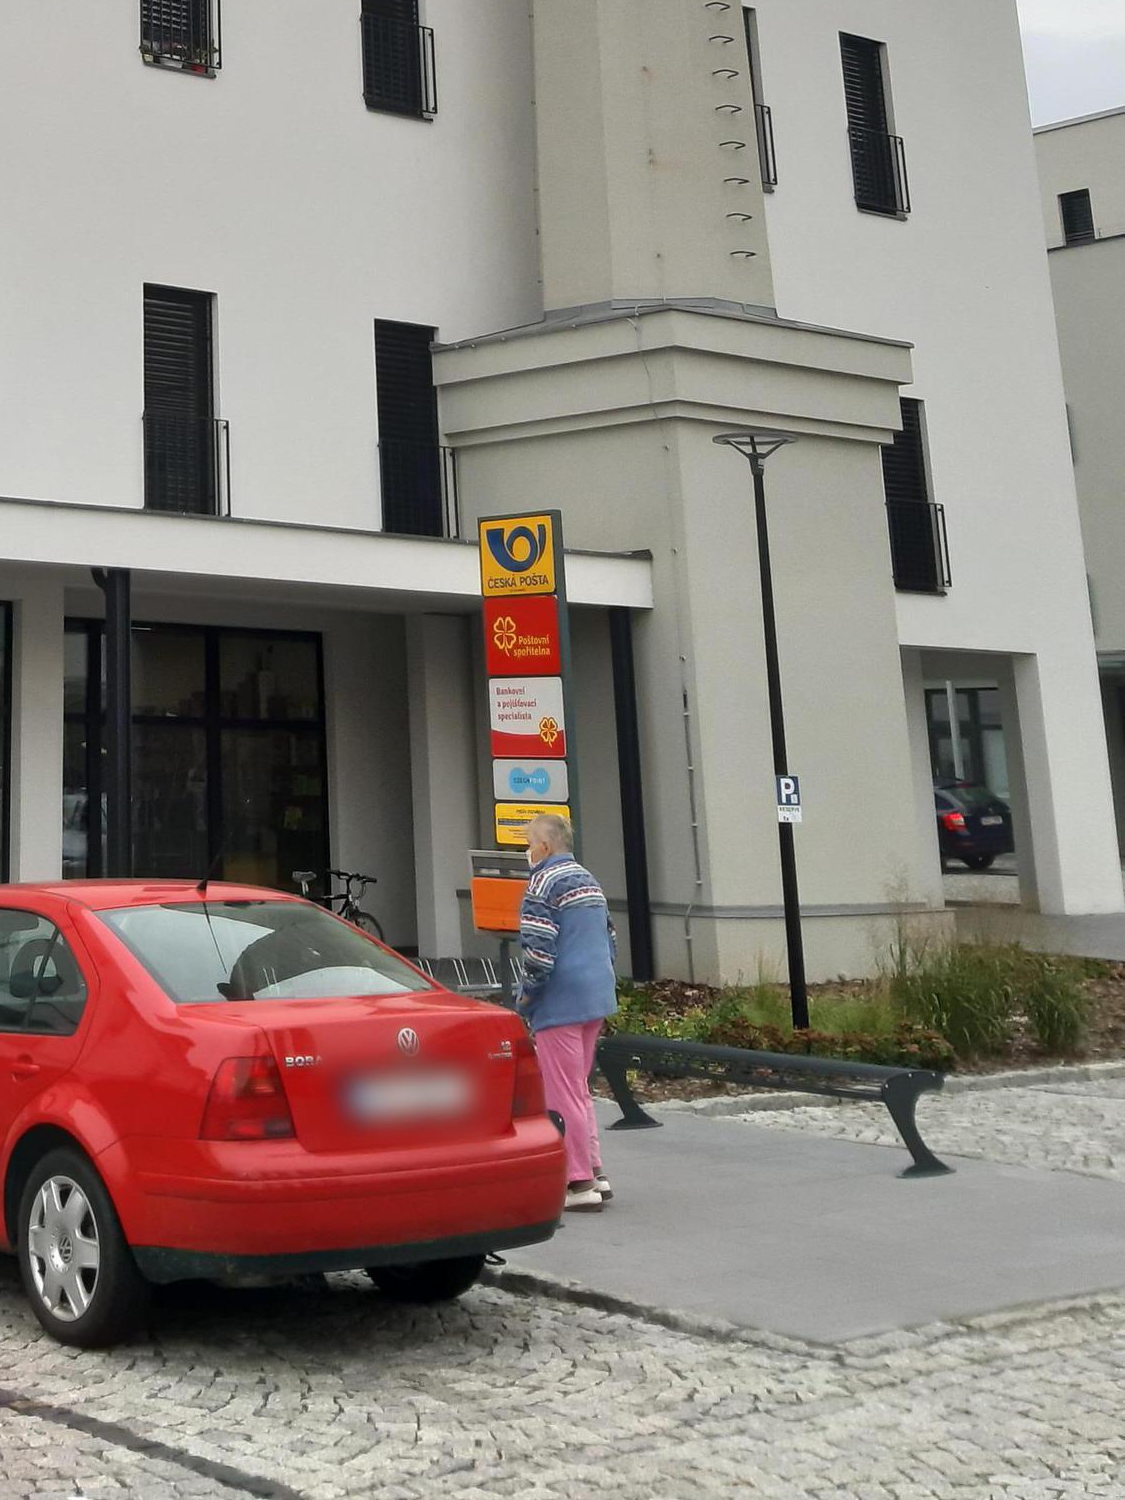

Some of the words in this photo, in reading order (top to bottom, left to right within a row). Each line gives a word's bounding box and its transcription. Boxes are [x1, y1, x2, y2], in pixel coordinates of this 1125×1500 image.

[487, 574, 516, 589] ČESKÁ
[519, 573, 549, 587] POŠTA
[518, 635, 549, 645] Poštovní
[513, 646, 550, 657] spořitelna
[498, 712, 532, 721] specialista
[780, 778, 795, 804] P
[284, 1055, 323, 1067] BORA
